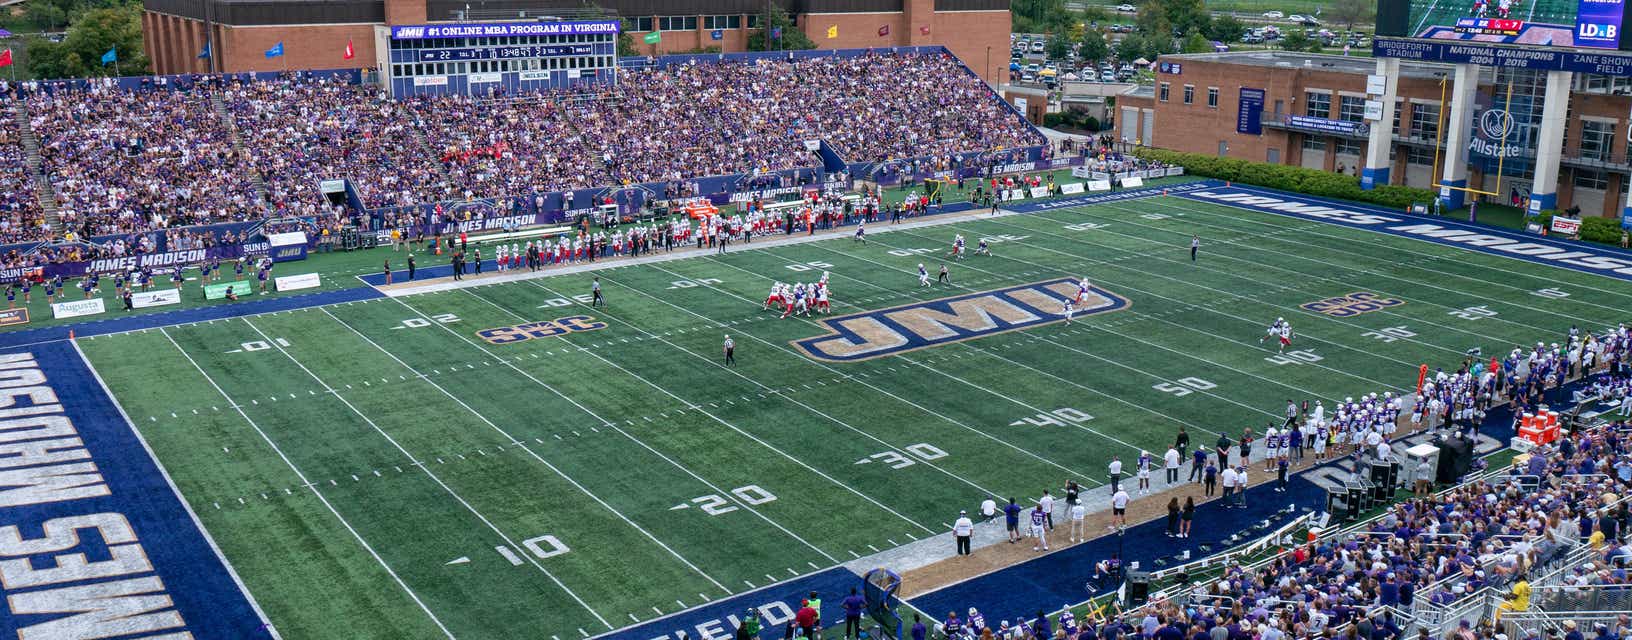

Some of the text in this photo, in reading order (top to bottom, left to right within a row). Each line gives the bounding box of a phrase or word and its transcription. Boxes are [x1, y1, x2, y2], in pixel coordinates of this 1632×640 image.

[396, 23, 617, 38] JMU #1 ONLINE MBA PROGRAM IN VIRGINIA
[1378, 40, 1433, 52] BRIDGEFORTH
[1386, 49, 1422, 58] STADIUM
[1449, 46, 1555, 61] NATIONAL CHAMPIONS
[440, 51, 450, 59] 22
[1470, 56, 1528, 67] 2004 2016
[1574, 54, 1599, 64] ZANE
[1596, 64, 1624, 74] FIELD
[1468, 136, 1520, 158] Allstate
[1002, 162, 1036, 173] MADISON
[729, 190, 760, 202] JAMES
[1554, 220, 1577, 231] ESPN
[1190, 191, 1632, 276] JAMES MADIS
[244, 244, 262, 252] SUN
[277, 248, 302, 258] JMU
[86, 249, 207, 273] JAMES MADISON
[0, 268, 20, 279] SUN
[796, 278, 1128, 361] JMU
[475, 314, 608, 344] SBC
[1264, 350, 1324, 365] 40
[1152, 376, 1218, 398] 50
[1021, 407, 1095, 428] 40
[870, 442, 950, 470] 30
[692, 484, 778, 516] 20
[495, 534, 570, 566] 10
[0, 512, 194, 640] MES
